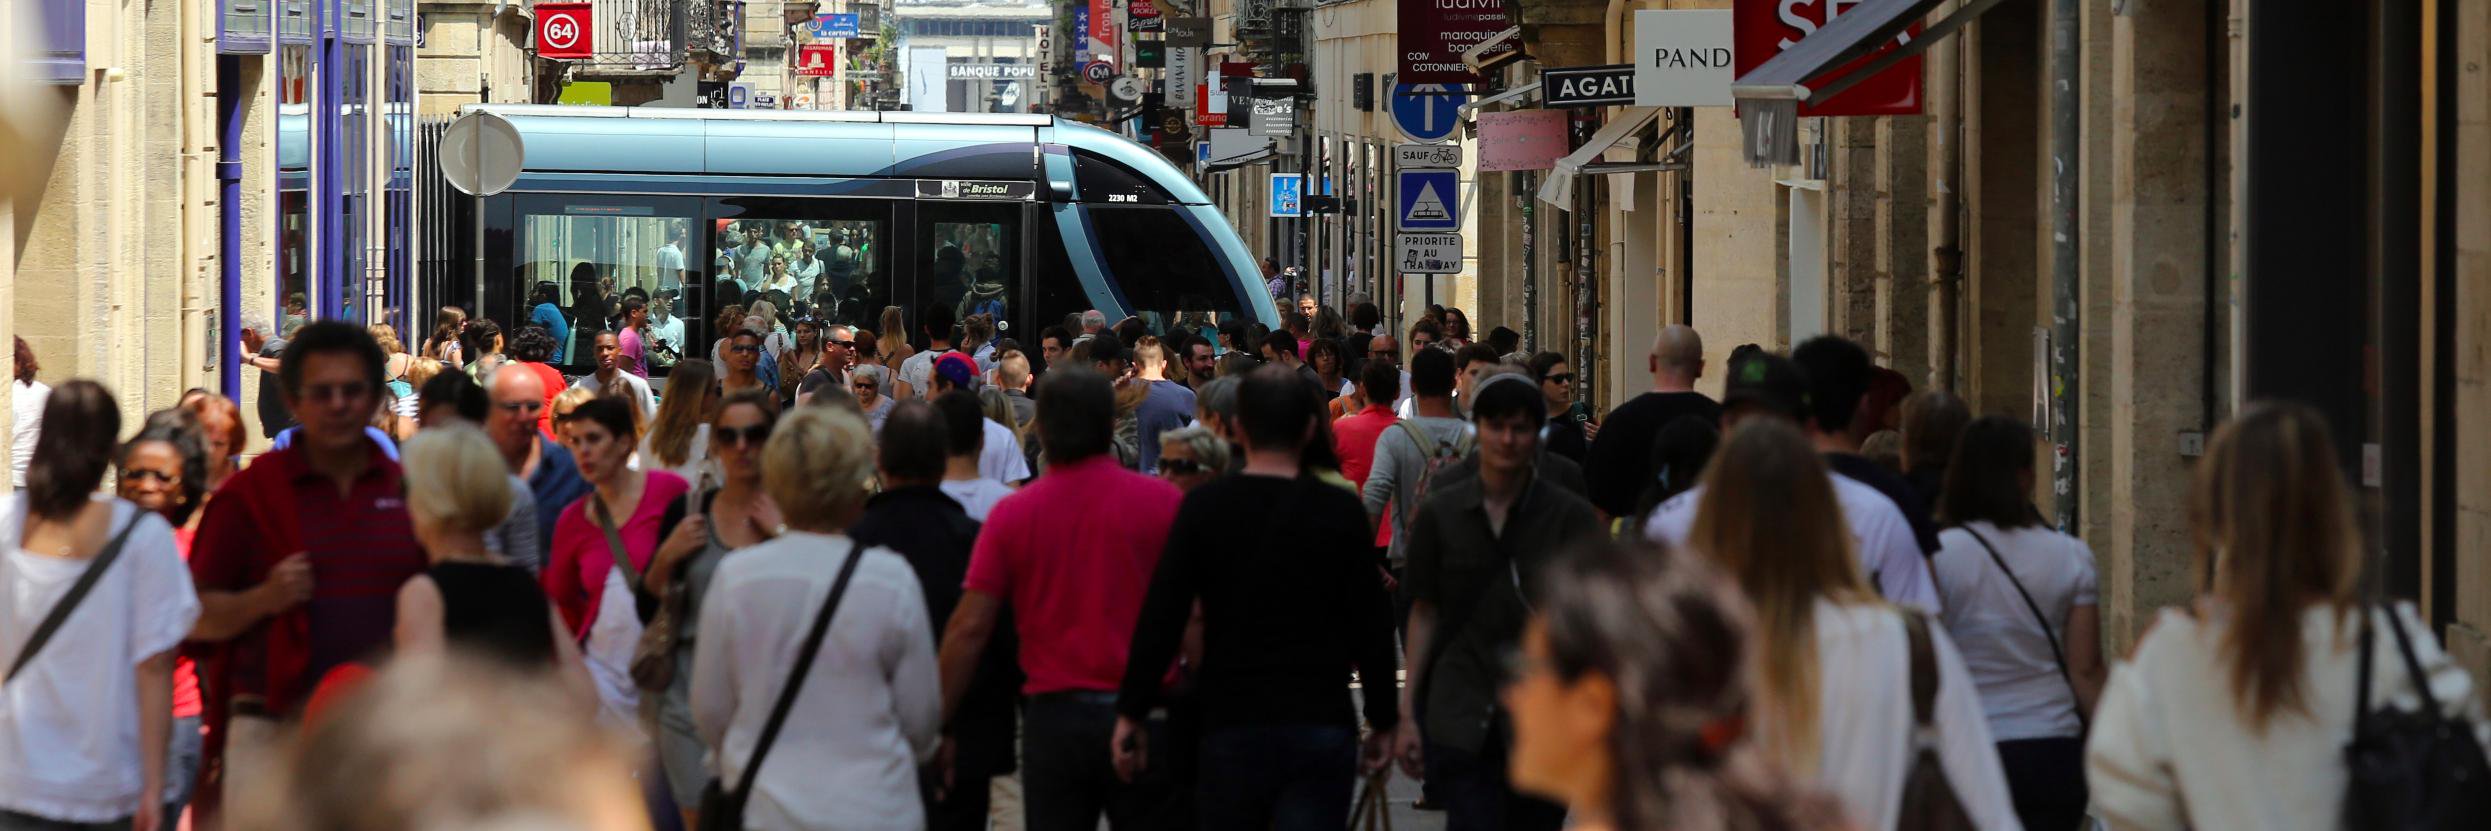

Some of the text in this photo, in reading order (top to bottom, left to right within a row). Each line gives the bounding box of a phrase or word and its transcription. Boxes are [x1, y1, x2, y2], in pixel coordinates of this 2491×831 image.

[550, 23, 573, 39] 64
[1040, 28, 1050, 83] HOTEL
[1655, 48, 1732, 69] PAND
[950, 66, 1035, 78] BANQUE POPU
[1089, 67, 1110, 79] C&A
[1559, 75, 1635, 97] AGAT
[1402, 151, 1430, 160] SAUF
[971, 184, 1008, 194] Bristol
[1108, 194, 1138, 202] 2230 M2
[1404, 236, 1456, 246] PRIORITE
[1423, 249, 1438, 257] AU
[1403, 261, 1457, 270] TRAAY
